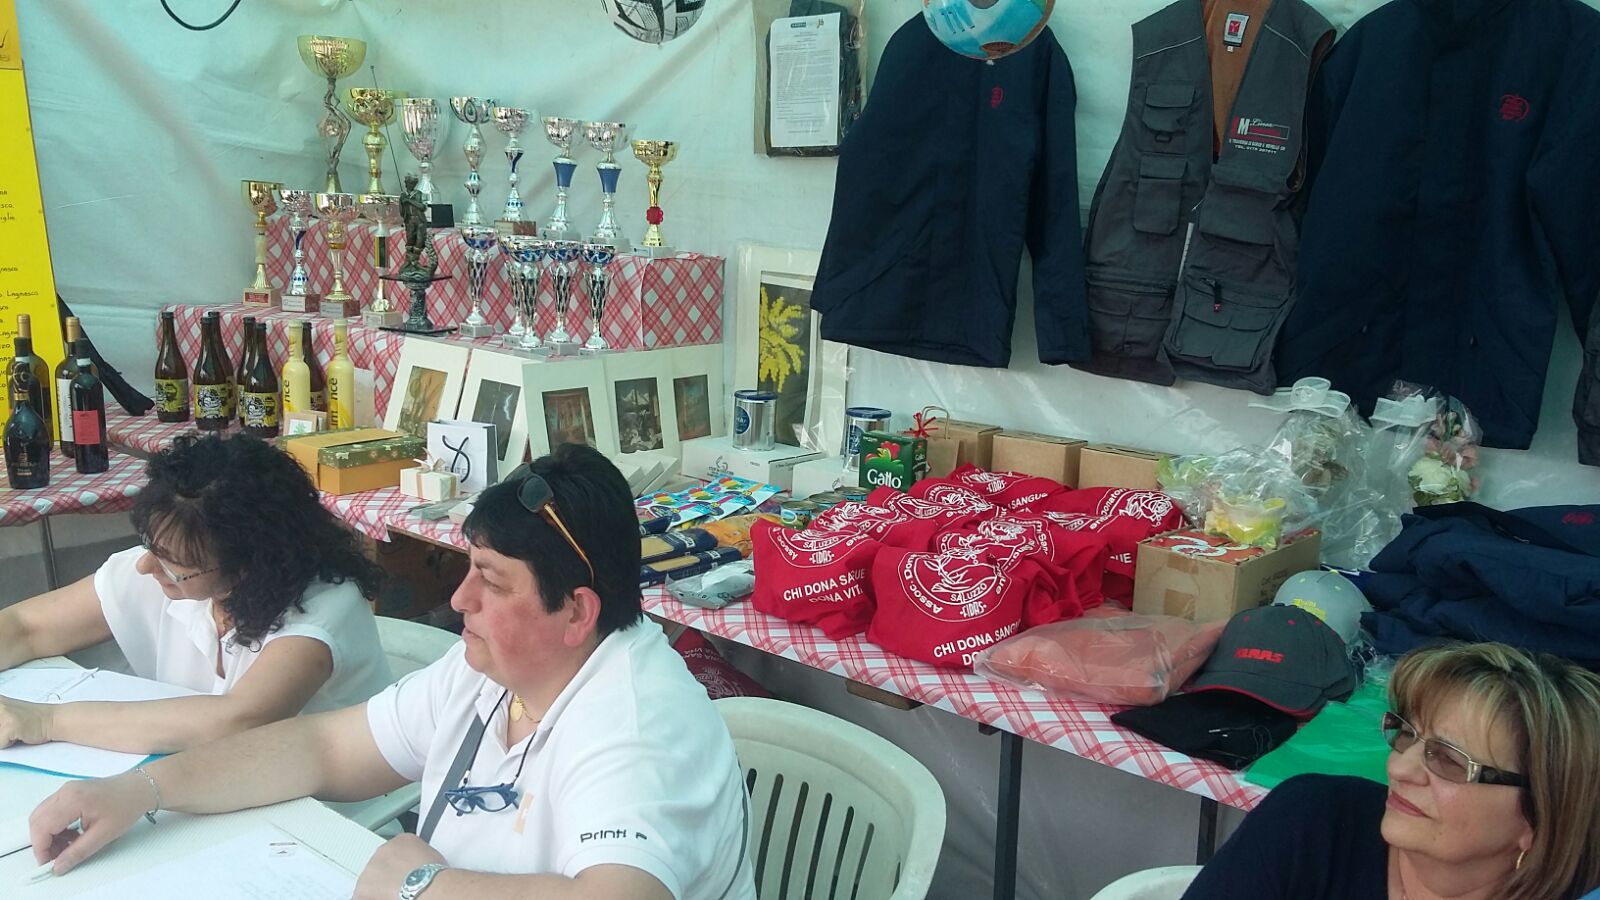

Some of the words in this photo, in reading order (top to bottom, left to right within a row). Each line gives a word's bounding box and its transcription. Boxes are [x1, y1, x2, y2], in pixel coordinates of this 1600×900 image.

[867, 468, 903, 489] Gallo
[783, 586, 803, 602] CHI
[804, 577, 839, 597] DONA
[949, 582, 988, 604] SALUZZO
[960, 601, 987, 618] FIDAS
[933, 643, 957, 658] CHI
[956, 632, 995, 652] DONA
